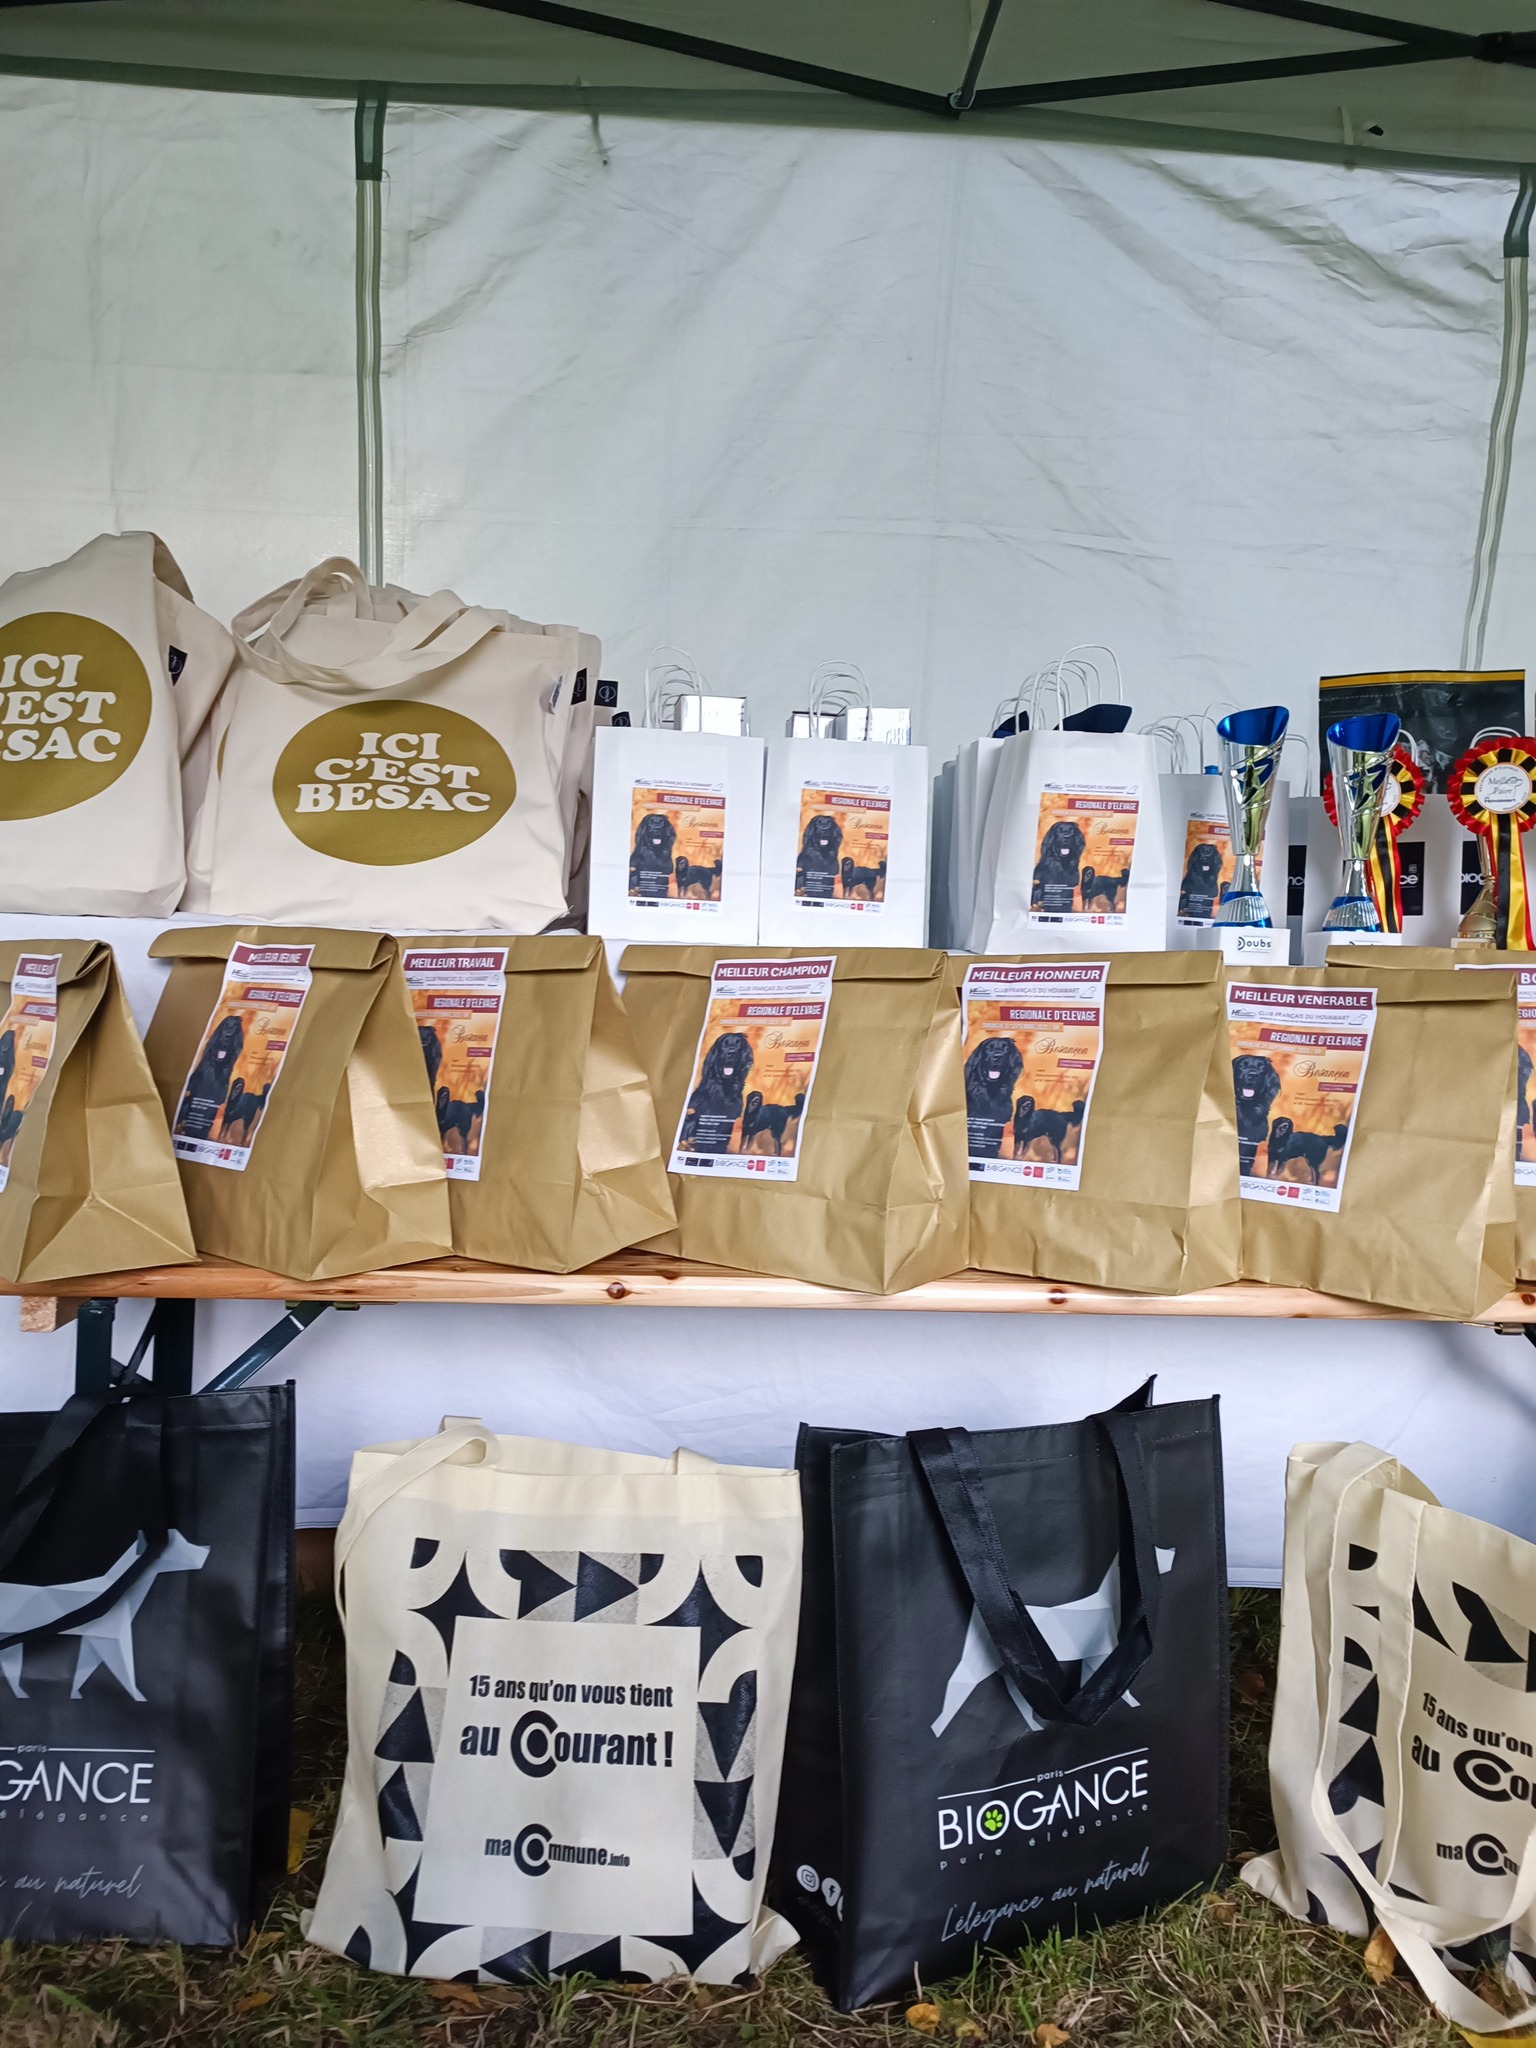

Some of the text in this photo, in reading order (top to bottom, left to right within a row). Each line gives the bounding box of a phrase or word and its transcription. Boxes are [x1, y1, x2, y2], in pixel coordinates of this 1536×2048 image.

[0, 652, 84, 688] ICI
[358, 732, 442, 760] ICI
[314, 758, 480, 789] C'EST
[295, 783, 491, 812] BESAC
[410, 957, 495, 968] MEILLEUR TRAVAIL
[718, 965, 828, 977] MEILLEUR CHAMPION
[972, 970, 1100, 980] MEILLEUR HONNEUR
[1235, 990, 1368, 1006] MEILLEUR VENERABLE
[1010, 1010, 1096, 1021] REGIONALE D'ELEVAGE
[1270, 1032, 1363, 1046] REGIONALE D'ELEVAGE
[469, 1675, 673, 1707] 15 ans qu'on vous tient
[1423, 1692, 1533, 1758] 15 ans qu'on
[18, 1744, 47, 1754] paris
[460, 1710, 674, 1778] au Courant !
[1412, 1735, 1440, 1772] au
[0, 1760, 154, 1803] GANCE
[1037, 1769, 1064, 1783] paris
[938, 1759, 1148, 1850] BIOGANCE
[940, 1848, 1001, 1870] pure
[1051, 1886, 1077, 1901] au
[1084, 1846, 1149, 1894] naturel
[54, 1864, 144, 1898] naturel
